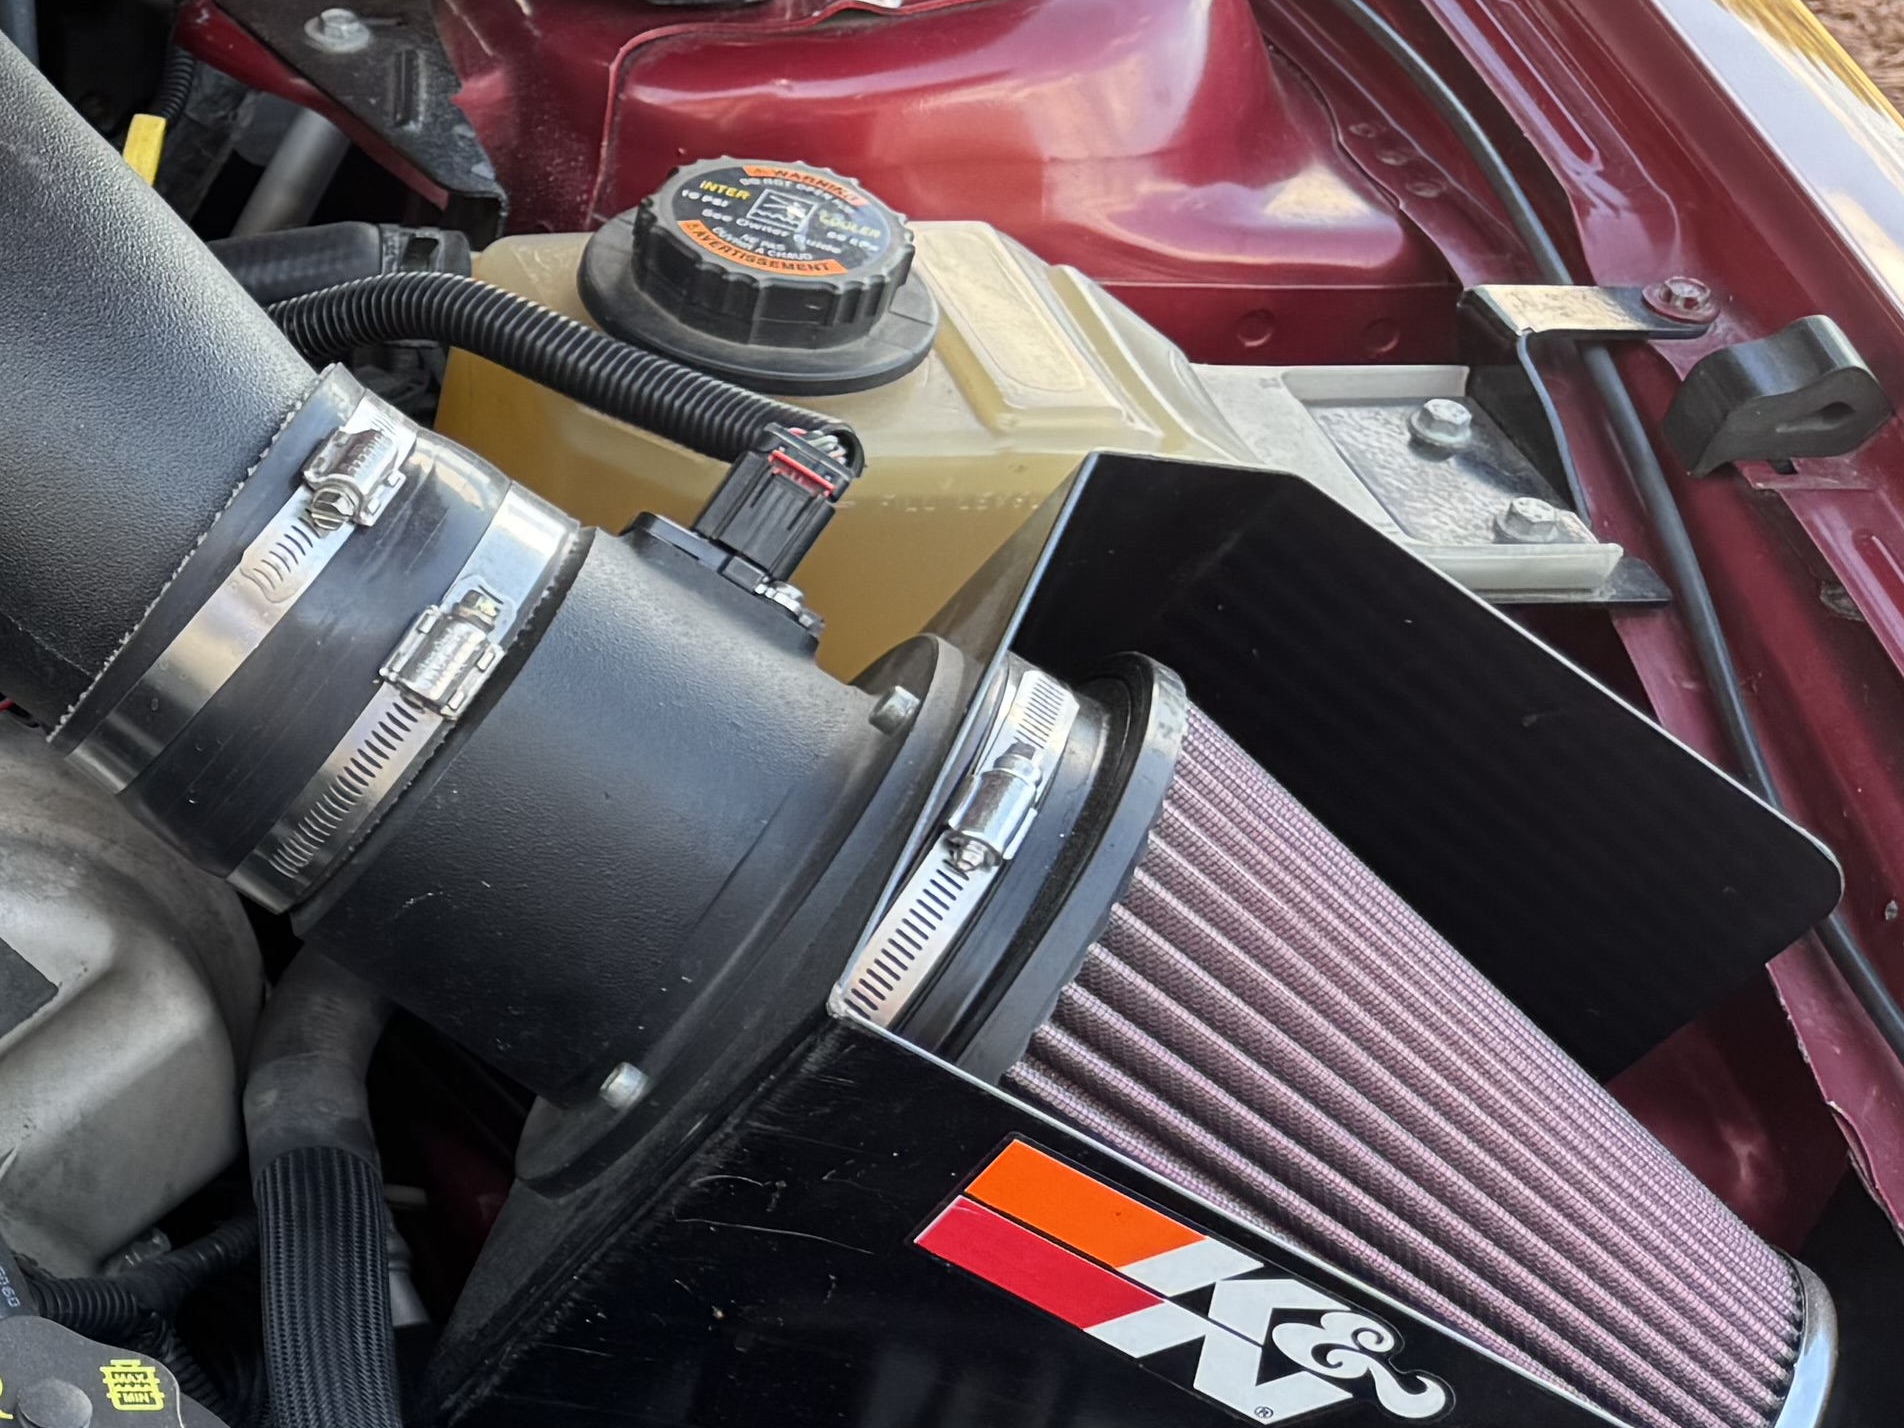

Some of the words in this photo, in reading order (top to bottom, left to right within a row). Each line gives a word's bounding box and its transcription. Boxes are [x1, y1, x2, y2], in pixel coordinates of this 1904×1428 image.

[698, 179, 751, 201] INTER
[113, 1371, 148, 1386] MAX
[121, 1390, 153, 1405] MIN
